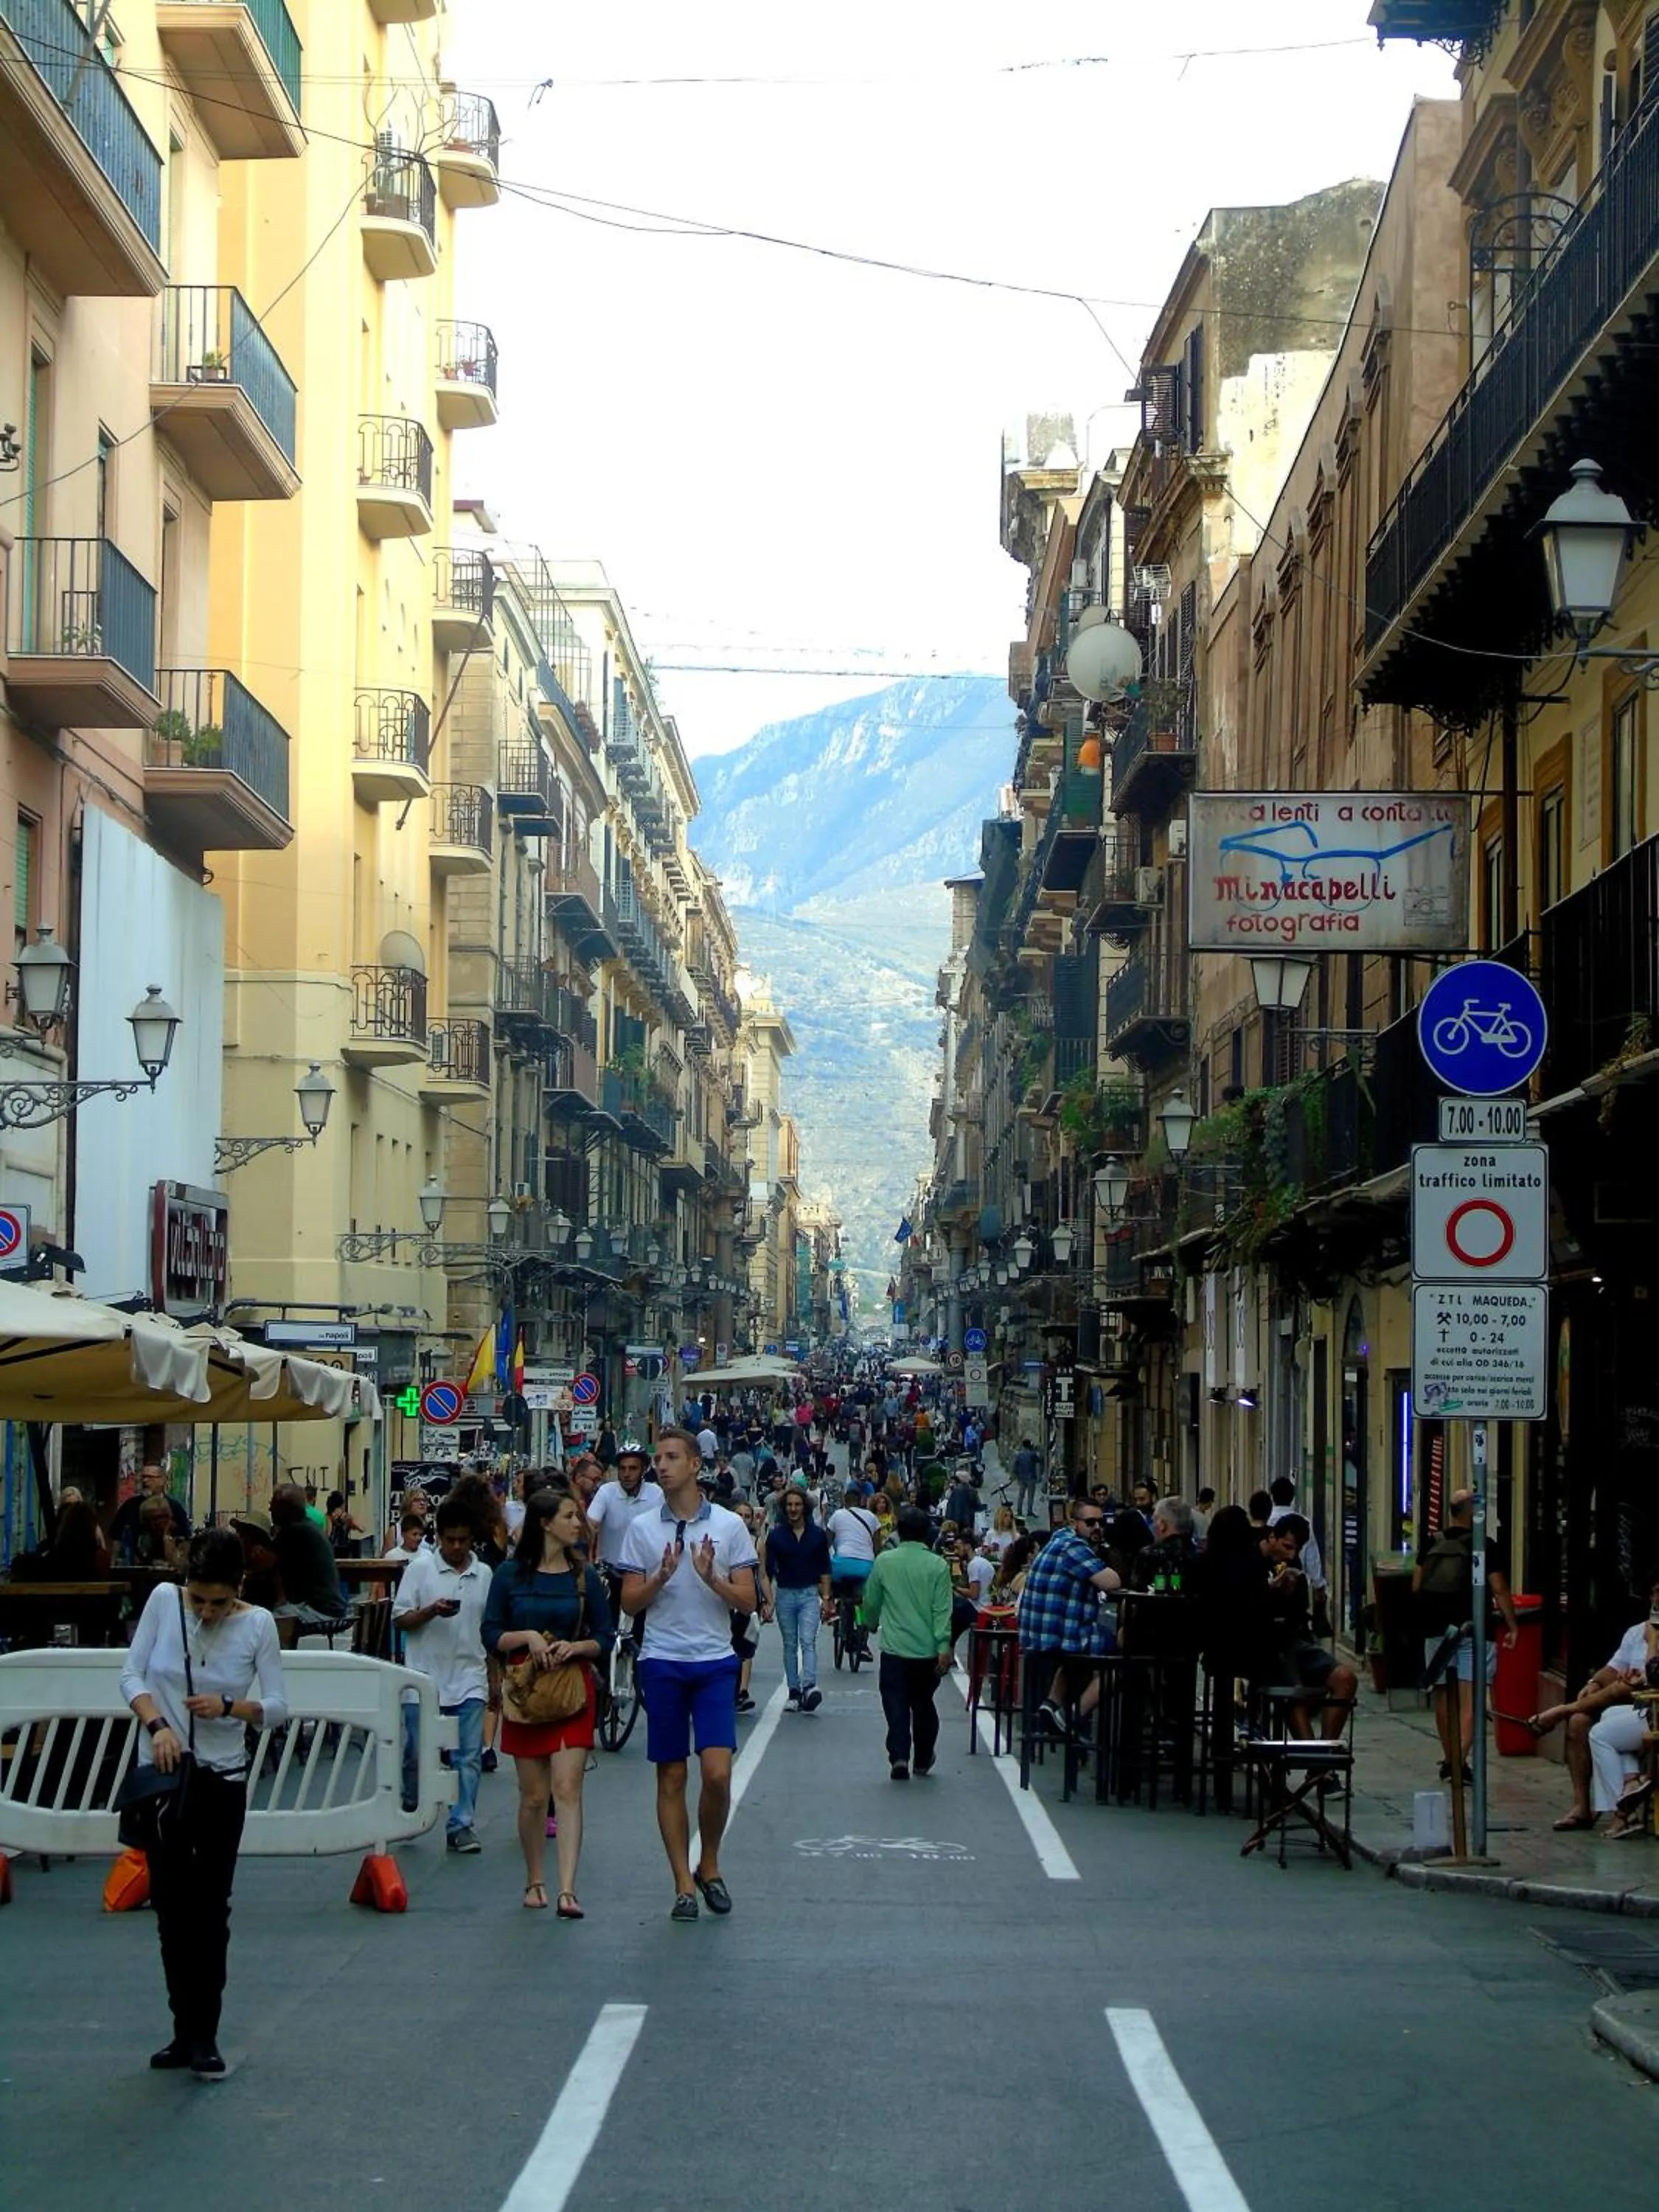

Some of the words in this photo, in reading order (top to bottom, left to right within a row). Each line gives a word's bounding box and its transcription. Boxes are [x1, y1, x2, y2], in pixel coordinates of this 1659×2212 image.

[1272, 801, 1320, 822] lenti
[1338, 806, 1353, 821] a
[1361, 801, 1455, 821] contat
[1226, 913, 1360, 942] fotografia
[1447, 1106, 1474, 1134] 7.00
[1487, 1106, 1520, 1135] 10.00
[1464, 1155, 1496, 1167] zona
[1419, 1173, 1476, 1188] traffico
[1482, 1173, 1542, 1188] limitato
[1456, 1312, 1489, 1326] 10,00
[1500, 1315, 1526, 1327] 7,00
[1470, 1331, 1478, 1343] 0
[1490, 1332, 1505, 1343] 24
